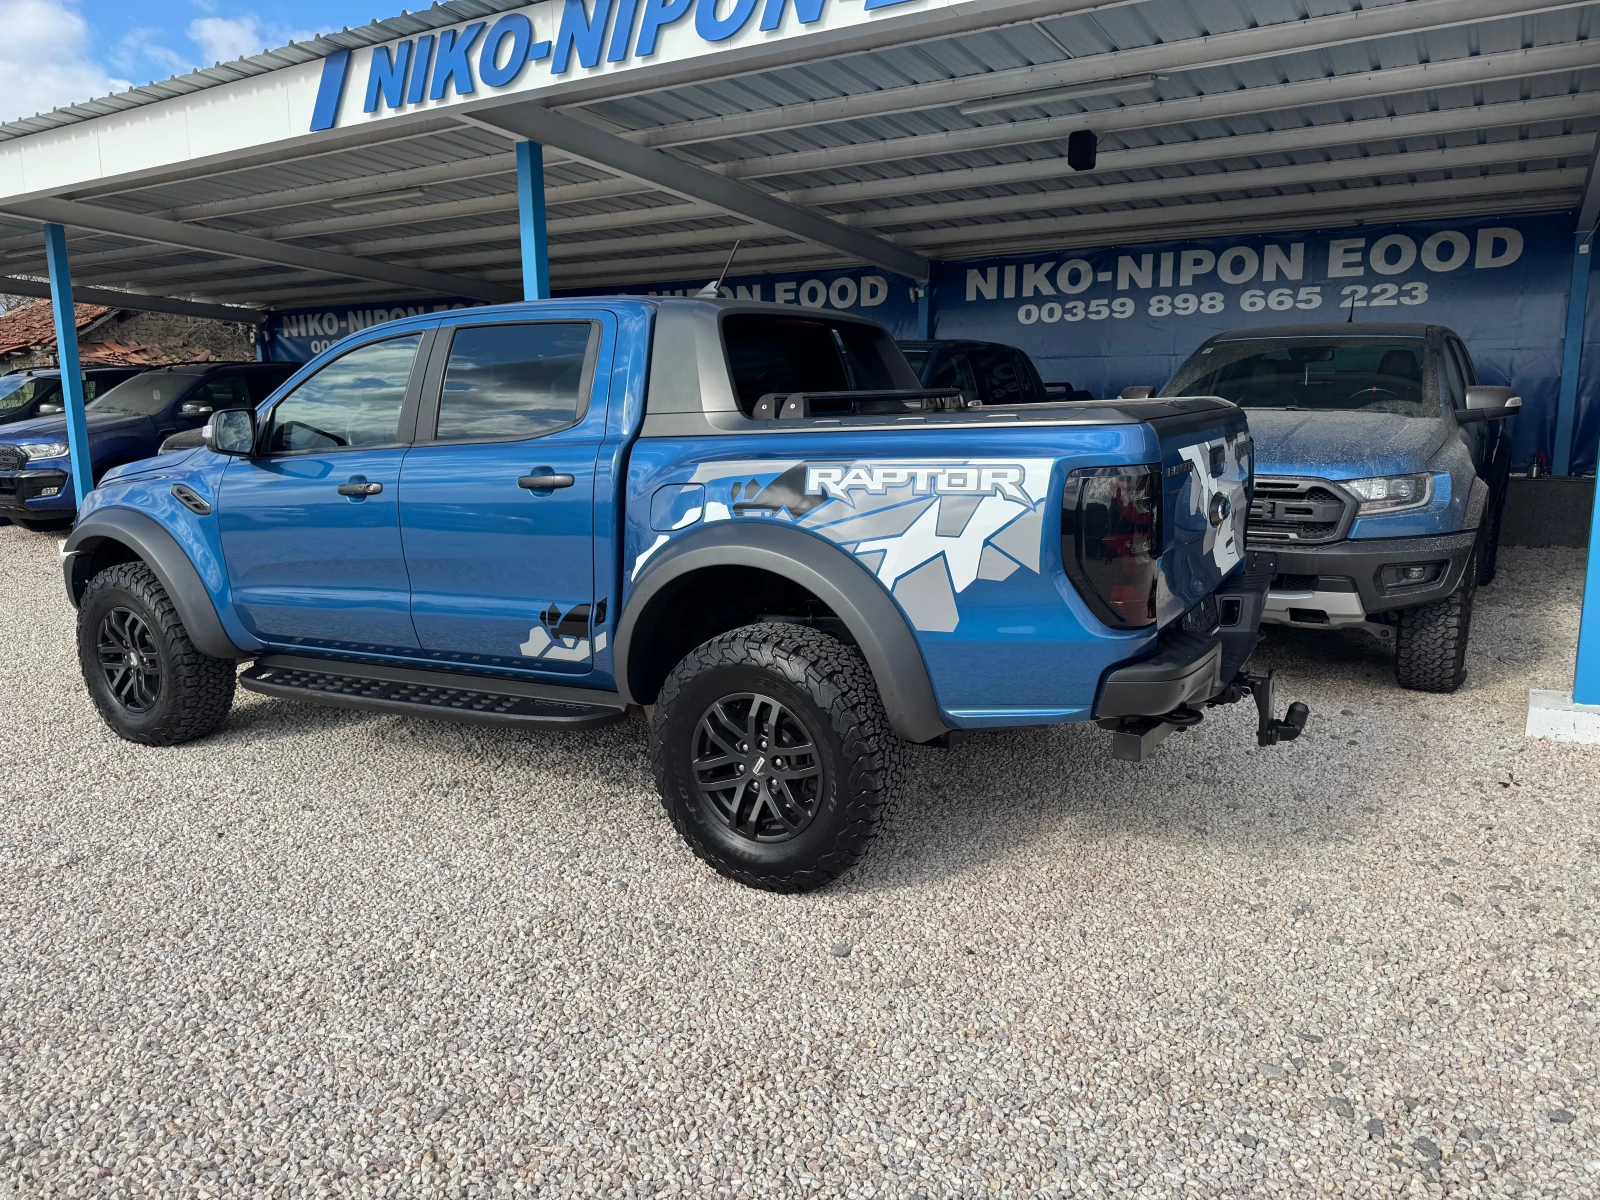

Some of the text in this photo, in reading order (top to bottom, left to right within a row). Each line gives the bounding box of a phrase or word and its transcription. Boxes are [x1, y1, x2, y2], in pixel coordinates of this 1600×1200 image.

[965, 226, 1525, 301] NIKO-NIPON EOOD
[774, 275, 889, 309] EOOD
[1017, 281, 1429, 325] 00359 898 665 223
[806, 465, 1036, 511] RAPTOR
